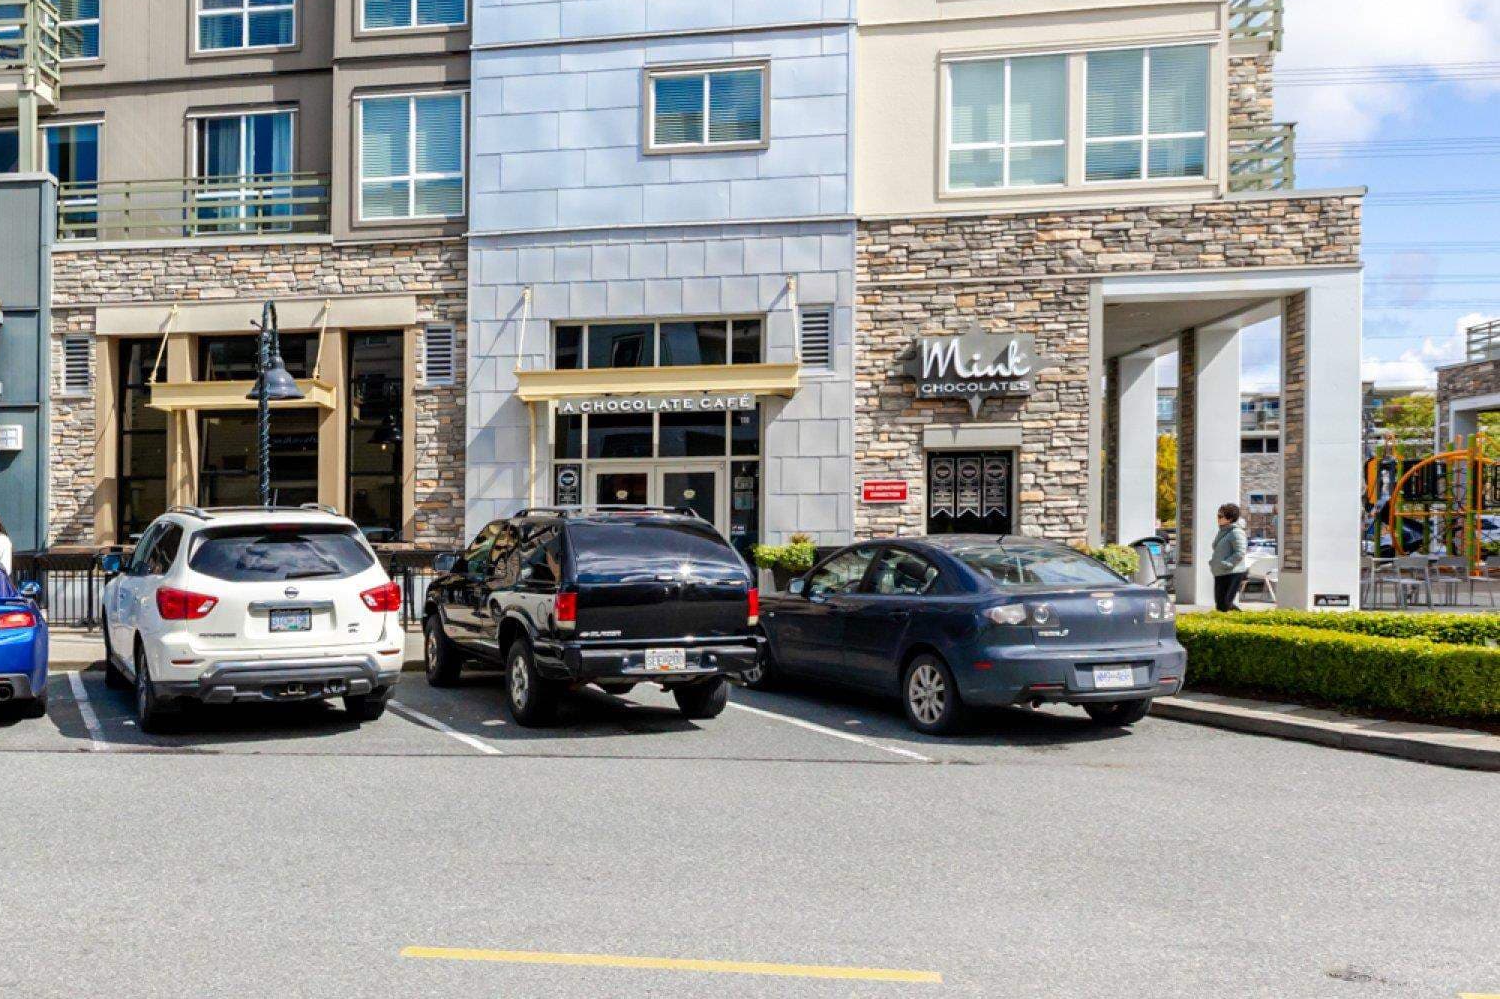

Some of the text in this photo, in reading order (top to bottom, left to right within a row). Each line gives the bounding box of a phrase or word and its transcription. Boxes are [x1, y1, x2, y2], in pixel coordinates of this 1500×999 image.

[922, 337, 1031, 378] Mink
[921, 382, 1030, 393] CHOCOLATES
[563, 393, 750, 412] A CHOCOLATE CAFÉ
